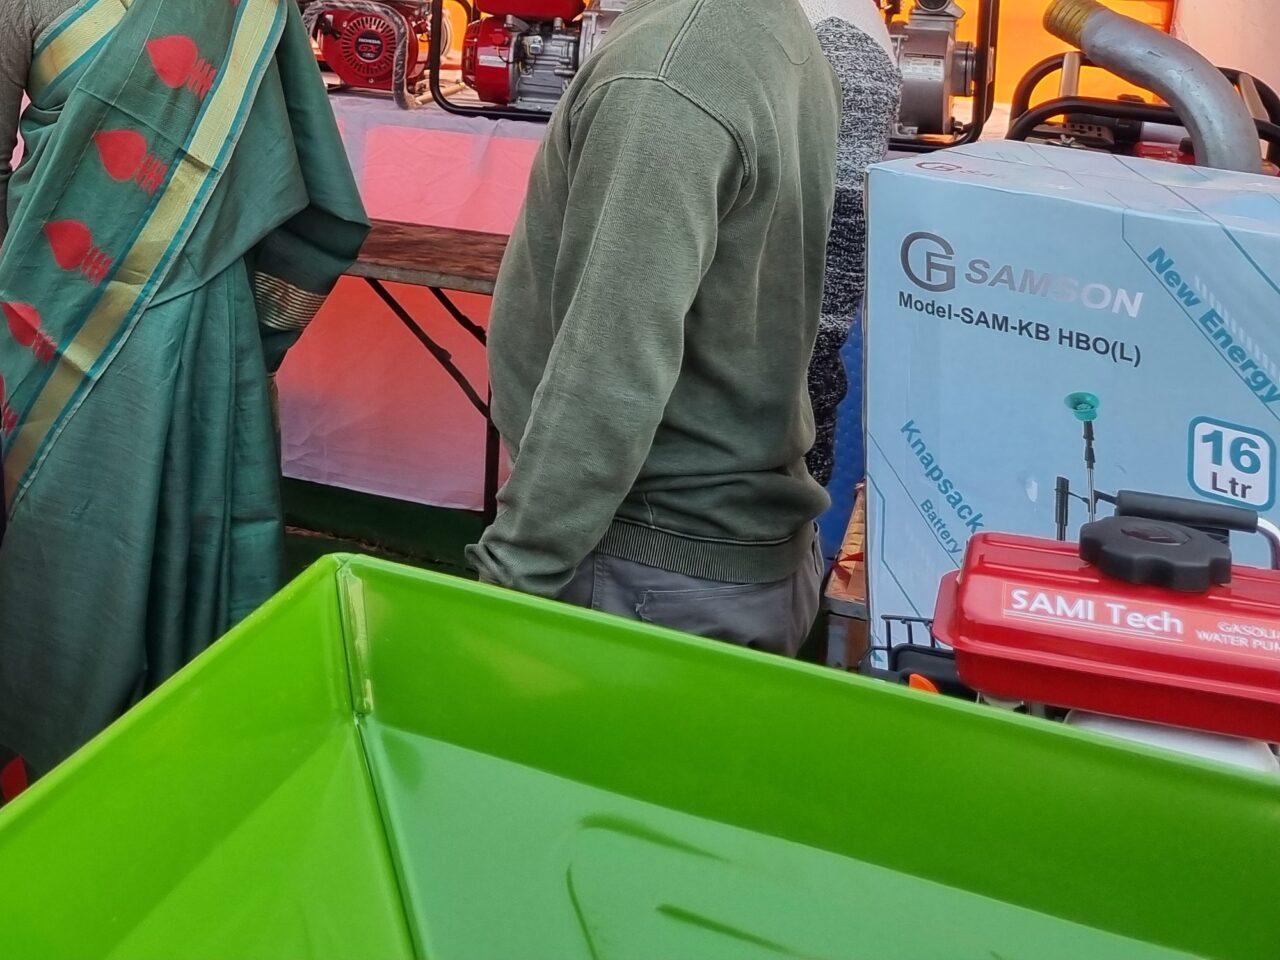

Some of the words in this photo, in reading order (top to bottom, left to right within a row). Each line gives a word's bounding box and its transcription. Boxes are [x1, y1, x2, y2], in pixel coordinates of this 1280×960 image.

[964, 258, 1144, 318] SAMSON
[898, 290, 1050, 342] Model-SAM-KB
[1058, 328, 1142, 368] HBO(L)
[1146, 247, 1202, 308] New
[1198, 308, 1280, 403] Energy
[900, 420, 984, 534] Knapsack
[1202, 429, 1262, 475] 16
[1211, 471, 1252, 499] Ltr
[920, 498, 962, 554] Battery
[1010, 589, 1096, 621] SAMI
[1105, 602, 1184, 634] Tech
[1217, 621, 1280, 640] GASOLI
[1195, 629, 1250, 648] WATER
